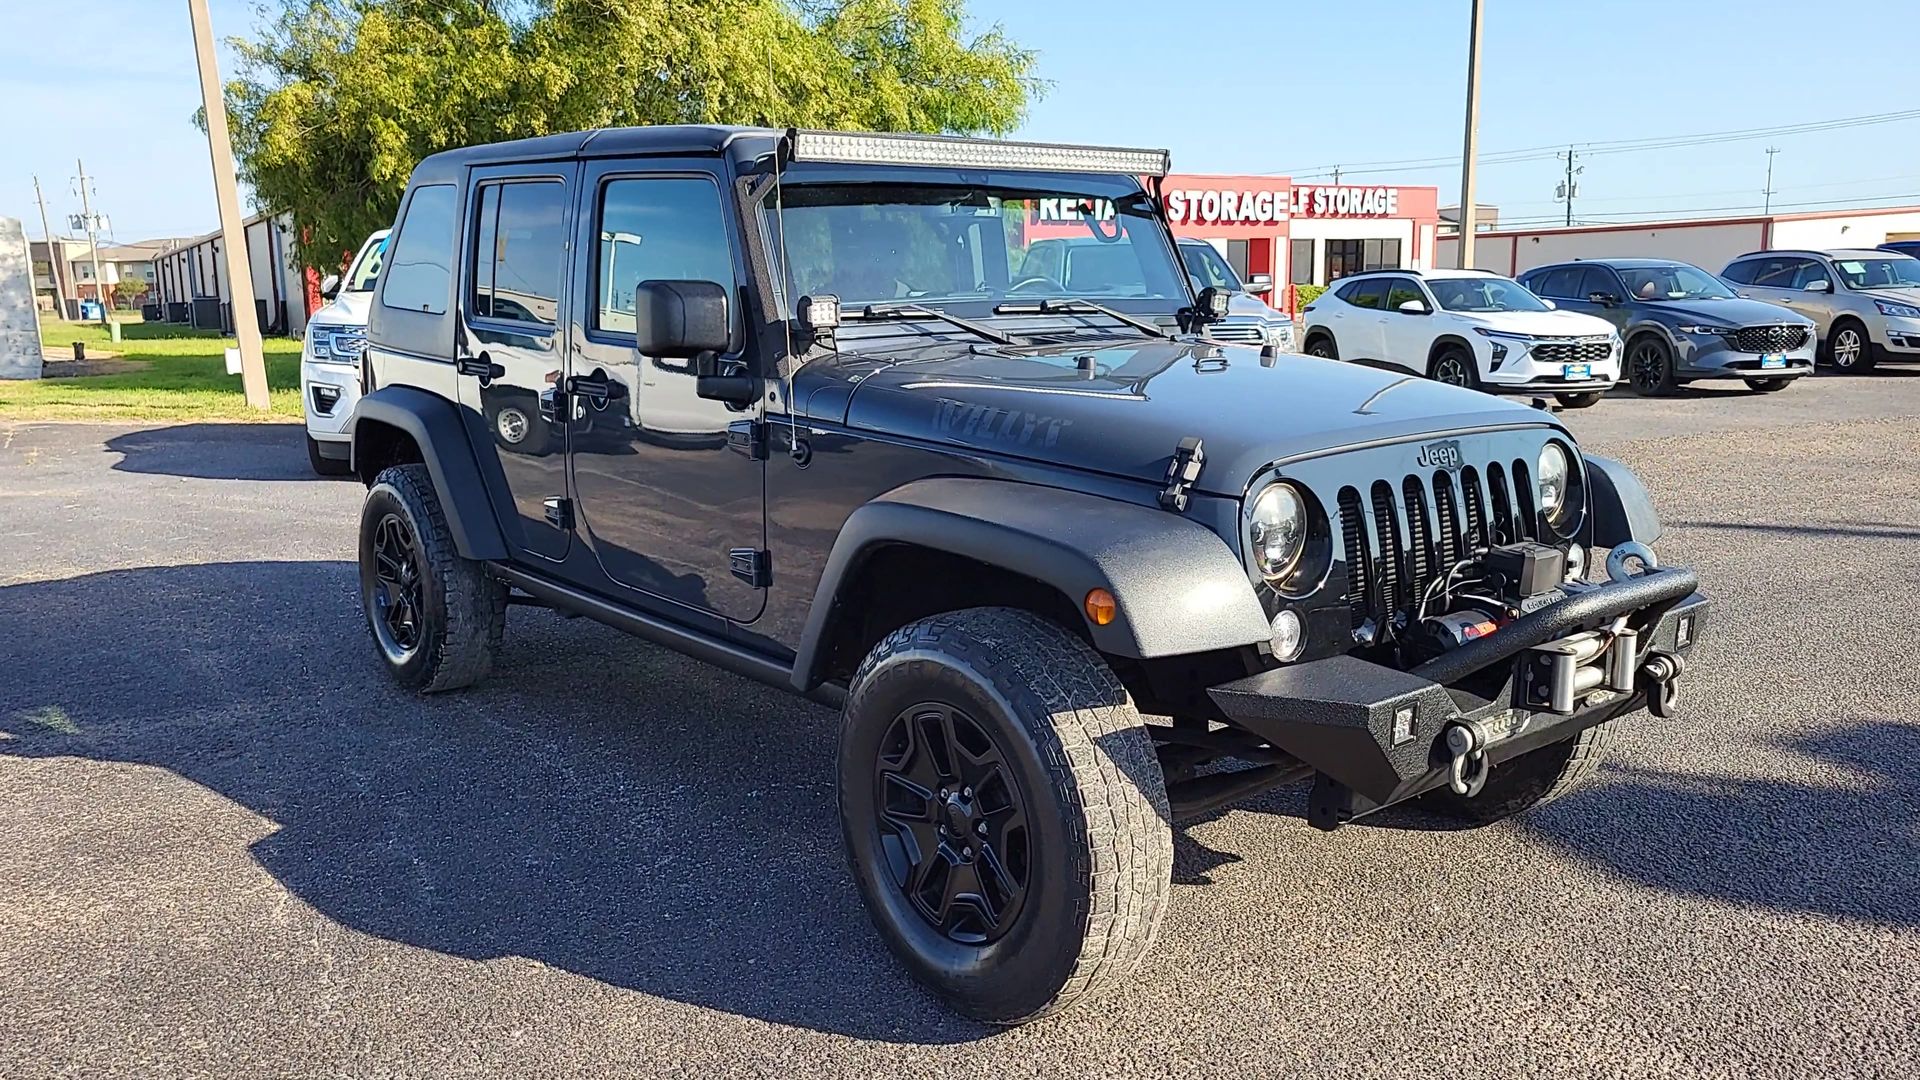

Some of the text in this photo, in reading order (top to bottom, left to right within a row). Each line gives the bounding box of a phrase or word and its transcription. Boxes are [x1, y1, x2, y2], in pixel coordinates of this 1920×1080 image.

[1168, 190, 1289, 222] STORAGE
[1290, 186, 1398, 215] LF STORAGE
[1417, 445, 1459, 468] Jeep
